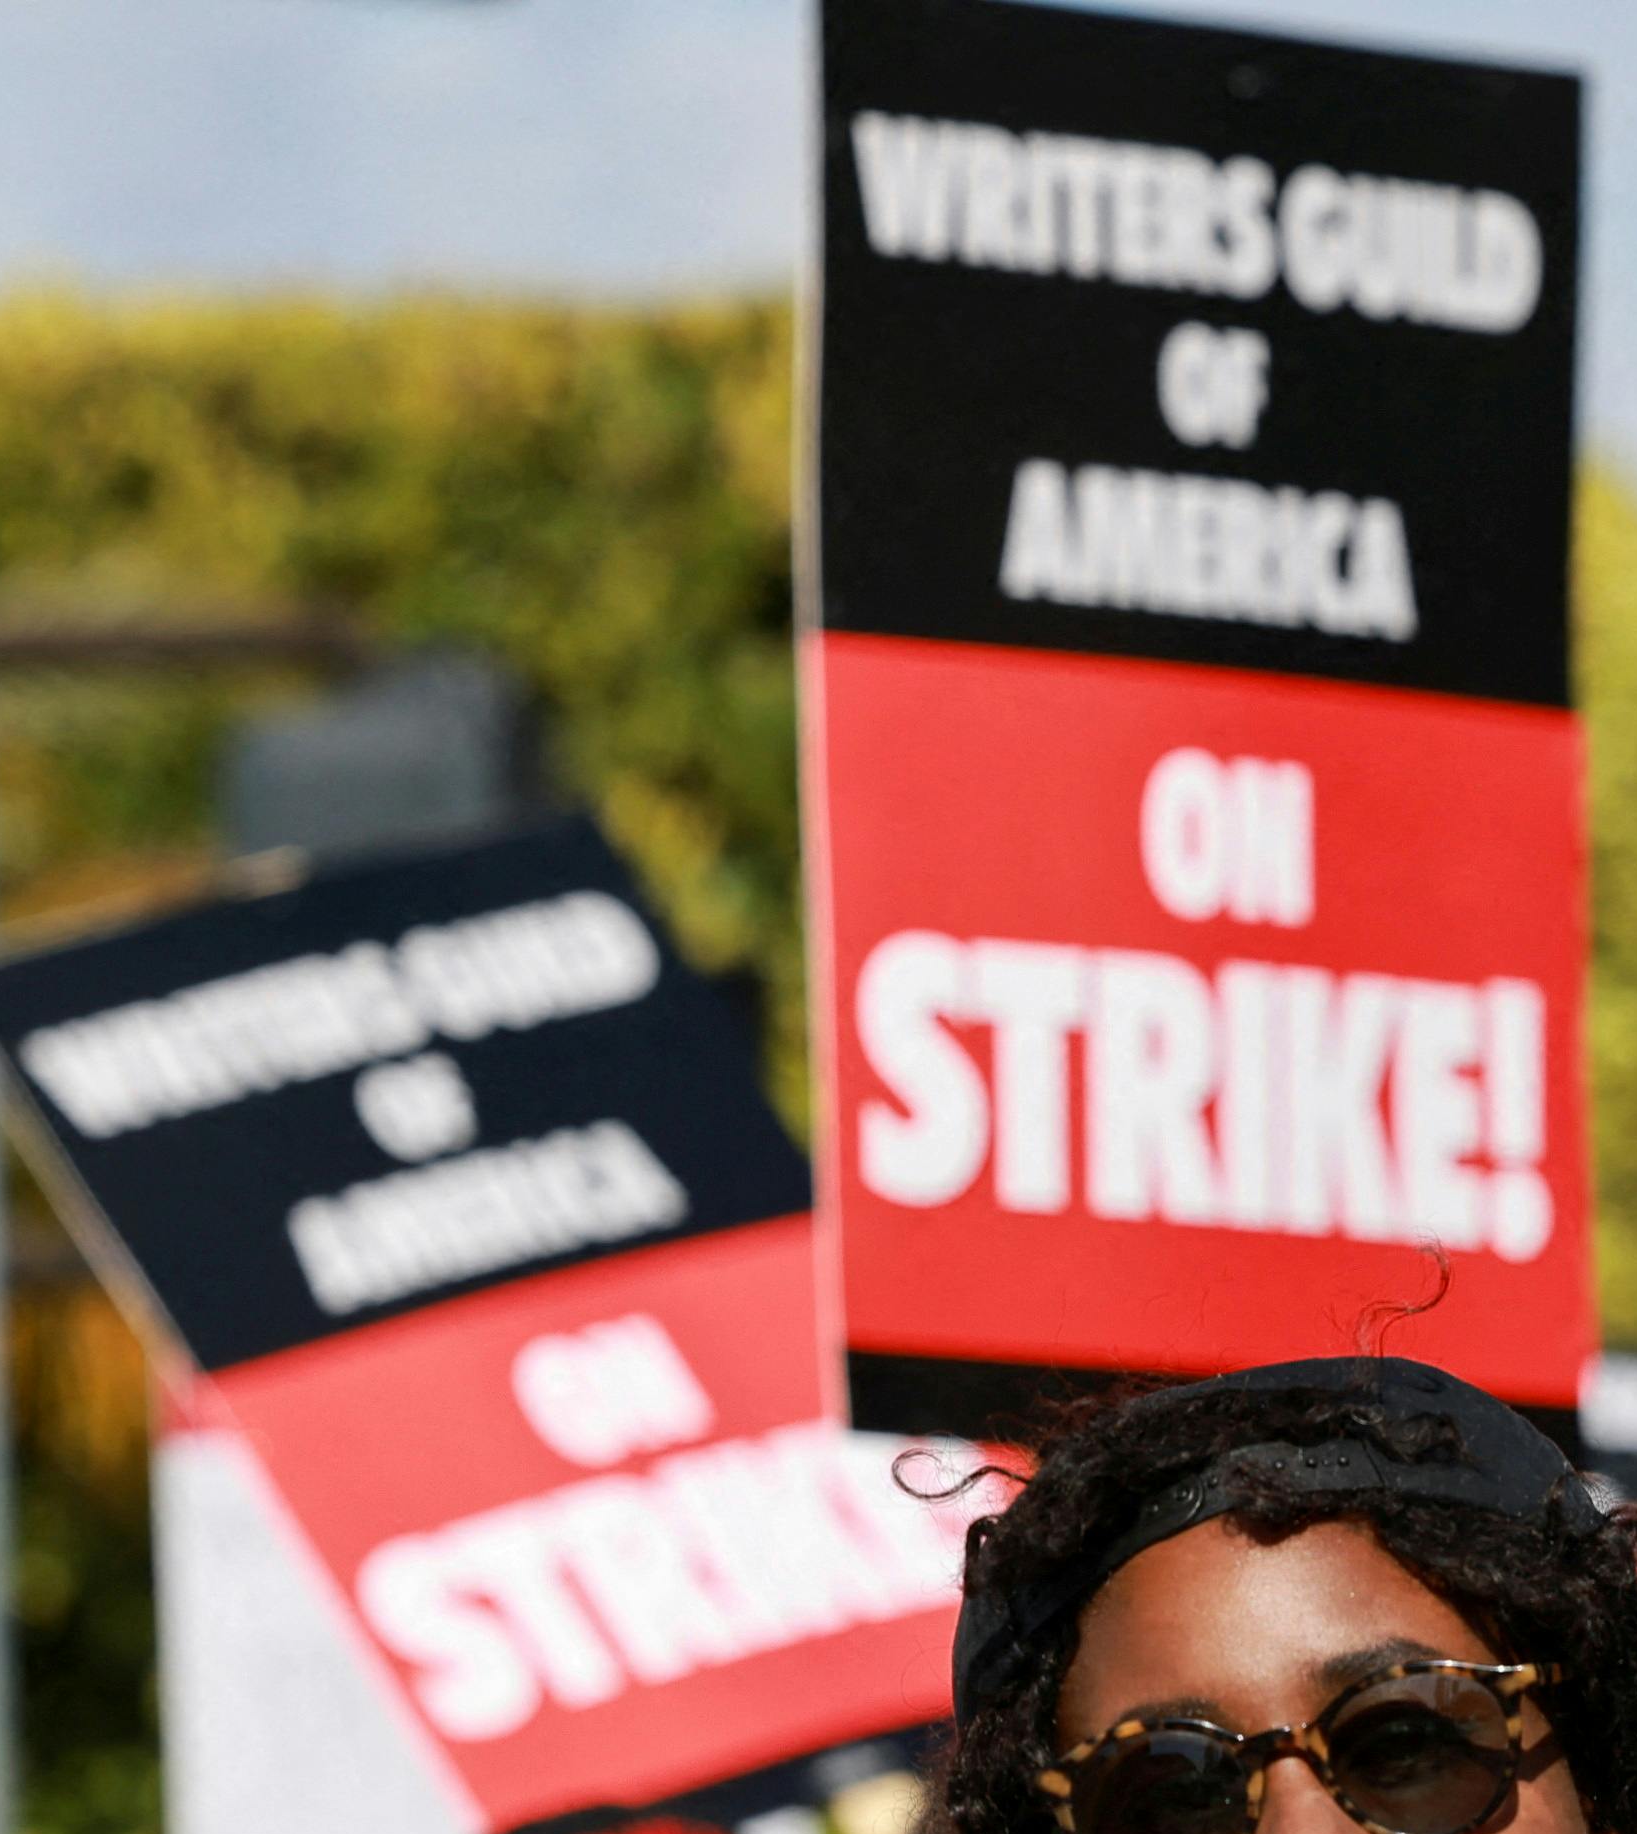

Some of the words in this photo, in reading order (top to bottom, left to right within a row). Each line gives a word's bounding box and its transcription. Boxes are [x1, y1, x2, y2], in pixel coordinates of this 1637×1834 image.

[852, 111, 1278, 301] WRITERS
[1281, 164, 1542, 336] GUILD
[1158, 322, 1271, 449] OF
[1000, 459, 1418, 642] AMERICA
[1139, 746, 1315, 926] ON
[853, 929, 1554, 1263] STRIKE!
